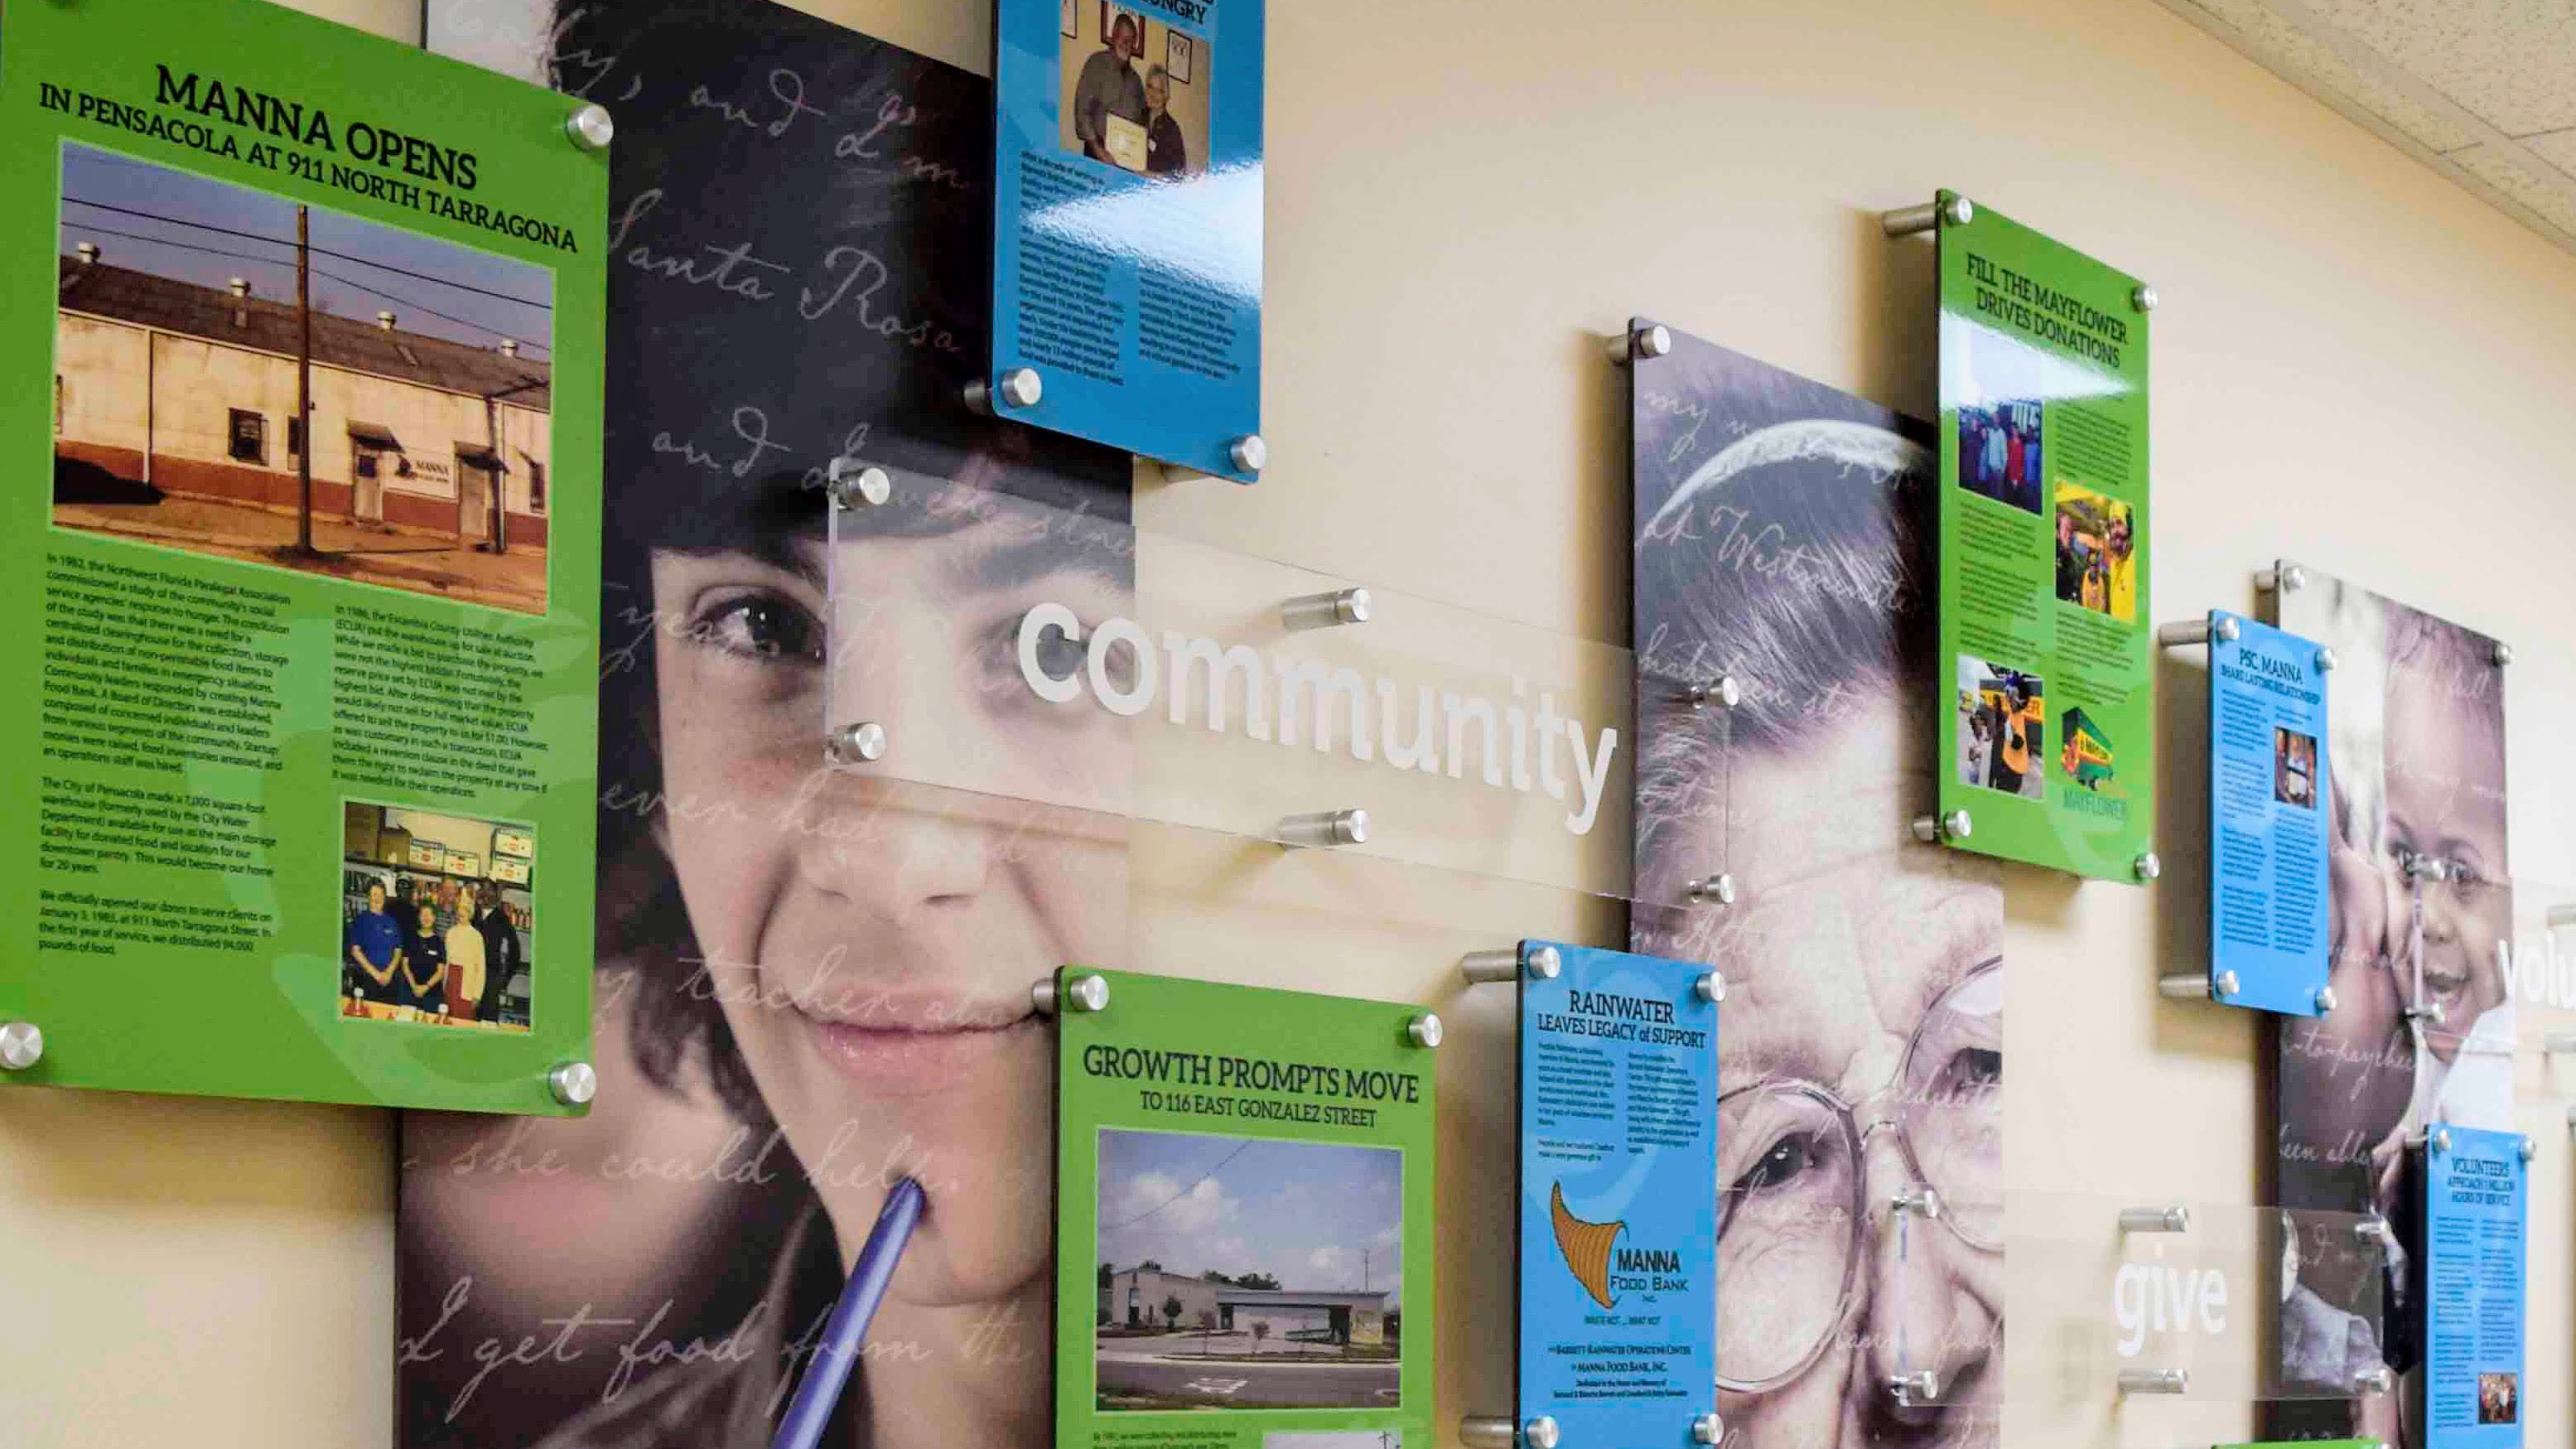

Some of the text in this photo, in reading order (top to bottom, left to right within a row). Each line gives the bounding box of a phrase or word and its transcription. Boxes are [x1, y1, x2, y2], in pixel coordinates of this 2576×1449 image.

[155, 63, 477, 190] MANNA OPENS
[40, 82, 578, 254] IN PENSACOLA AT 911 NORTH TARRAGONA
[1966, 251, 2129, 345] FILL THE MAYFLOWER
[1975, 287, 2120, 369] DRIVES DONATIONS
[2261, 654, 2303, 684] MANNA
[1018, 602, 1618, 835] community
[1537, 1013, 1706, 1050] LEAVES LEGACY of SUPPORT
[1569, 990, 1675, 1025] RAINWATER
[1083, 1044, 1420, 1104] GROWTH PROMPTS MOVE
[1140, 1090, 1377, 1128] TO 116 EAST GONZALEZ STREET
[602, 1124, 780, 1186] could
[2452, 1157, 2509, 1177] VOLUNTEERS
[1617, 1249, 1681, 1273] MANNA
[2114, 1242, 2227, 1357] give
[445, 1302, 636, 1425] get
[602, 1298, 764, 1405] food
